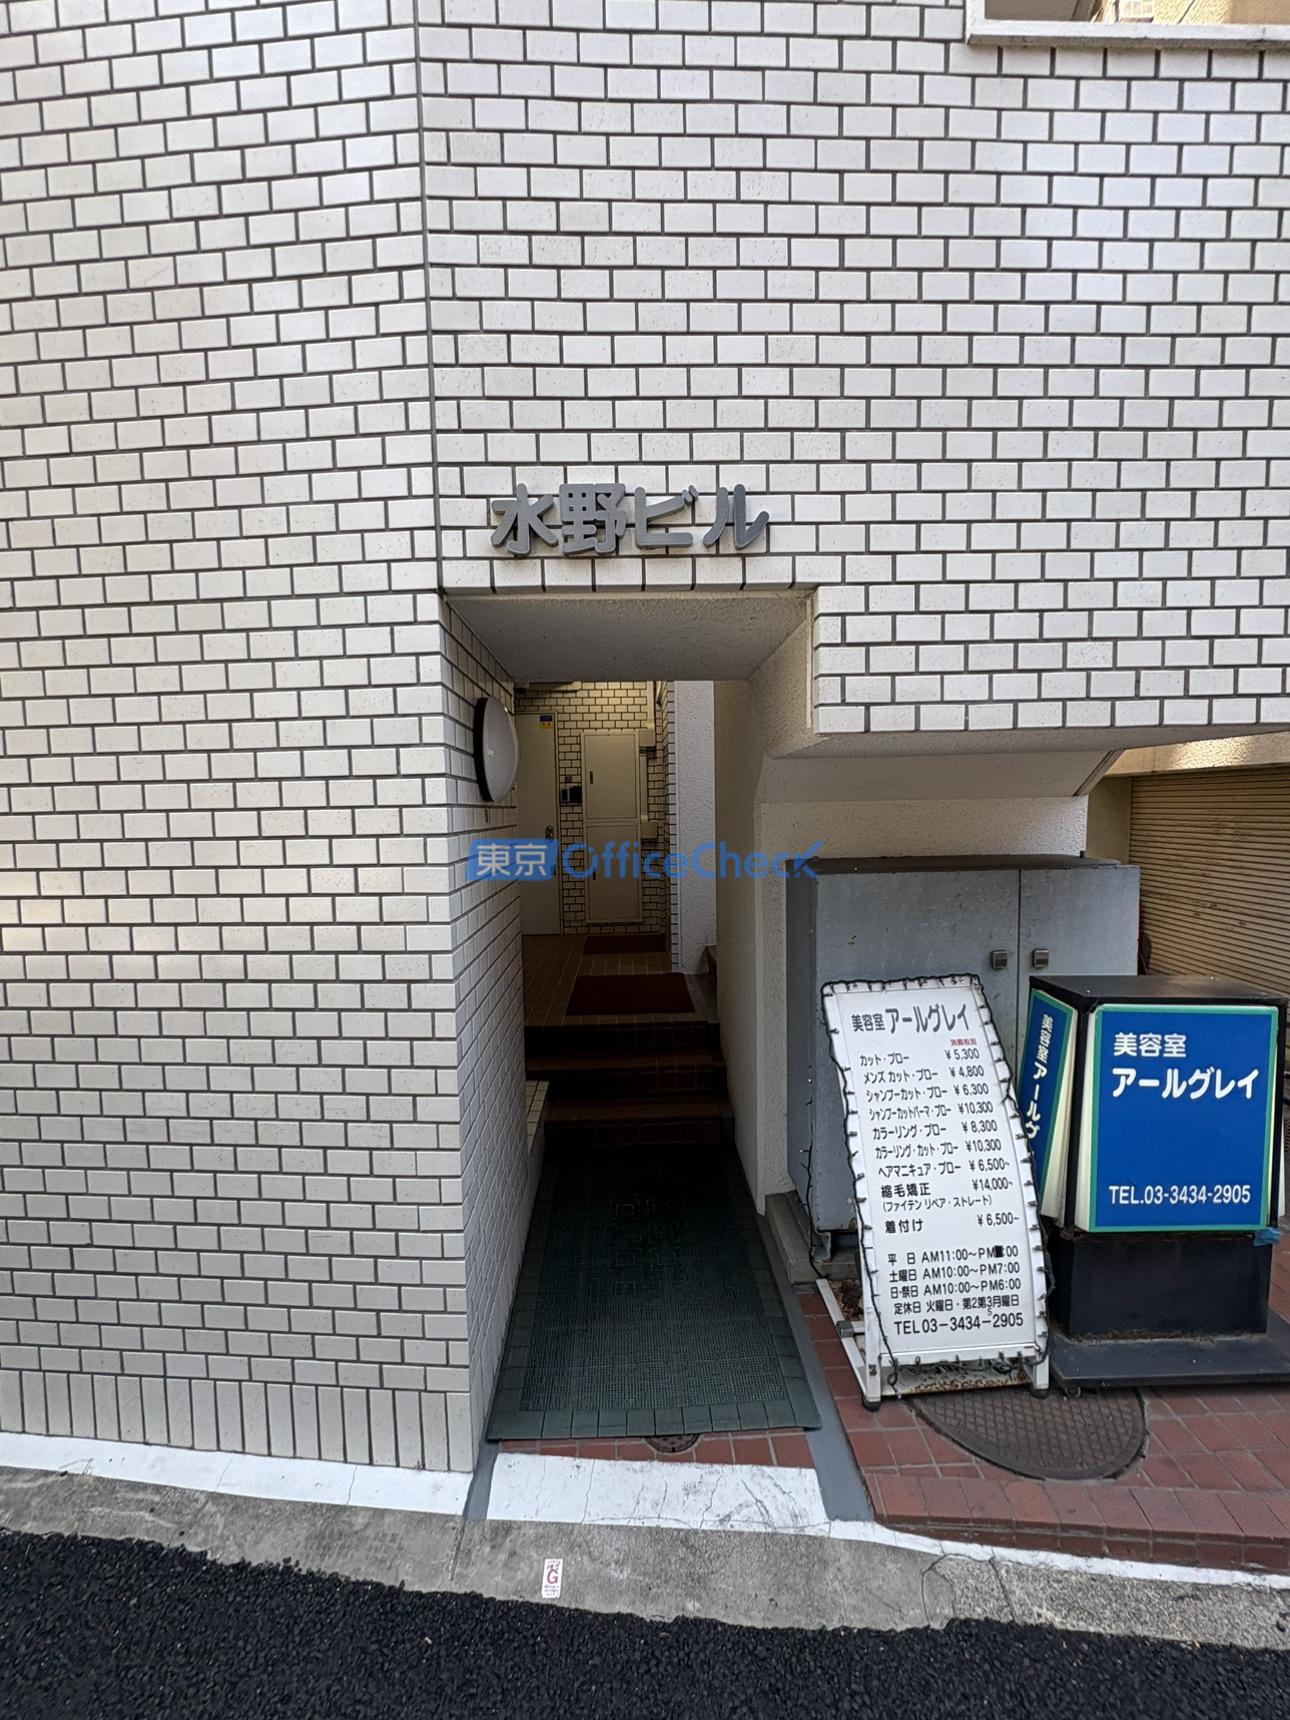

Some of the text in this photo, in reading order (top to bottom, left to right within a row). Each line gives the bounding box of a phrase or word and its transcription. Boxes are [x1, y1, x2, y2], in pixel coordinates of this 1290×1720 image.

[490, 483, 770, 556] 水野ビル
[851, 1003, 970, 1035] 美容室 アールグレイ
[1113, 1032, 1187, 1058] 美容室
[1112, 1066, 1259, 1100] アールグレイ
[881, 1182, 932, 1199] 縮毛矯正
[885, 1218, 924, 1234] 着付け
[921, 1244, 1019, 1264] AM11:00~PM:00
[889, 1269, 917, 1283] 土曜日
[894, 1301, 922, 1315] 定休日
[547, 1568, 559, 1584] G
